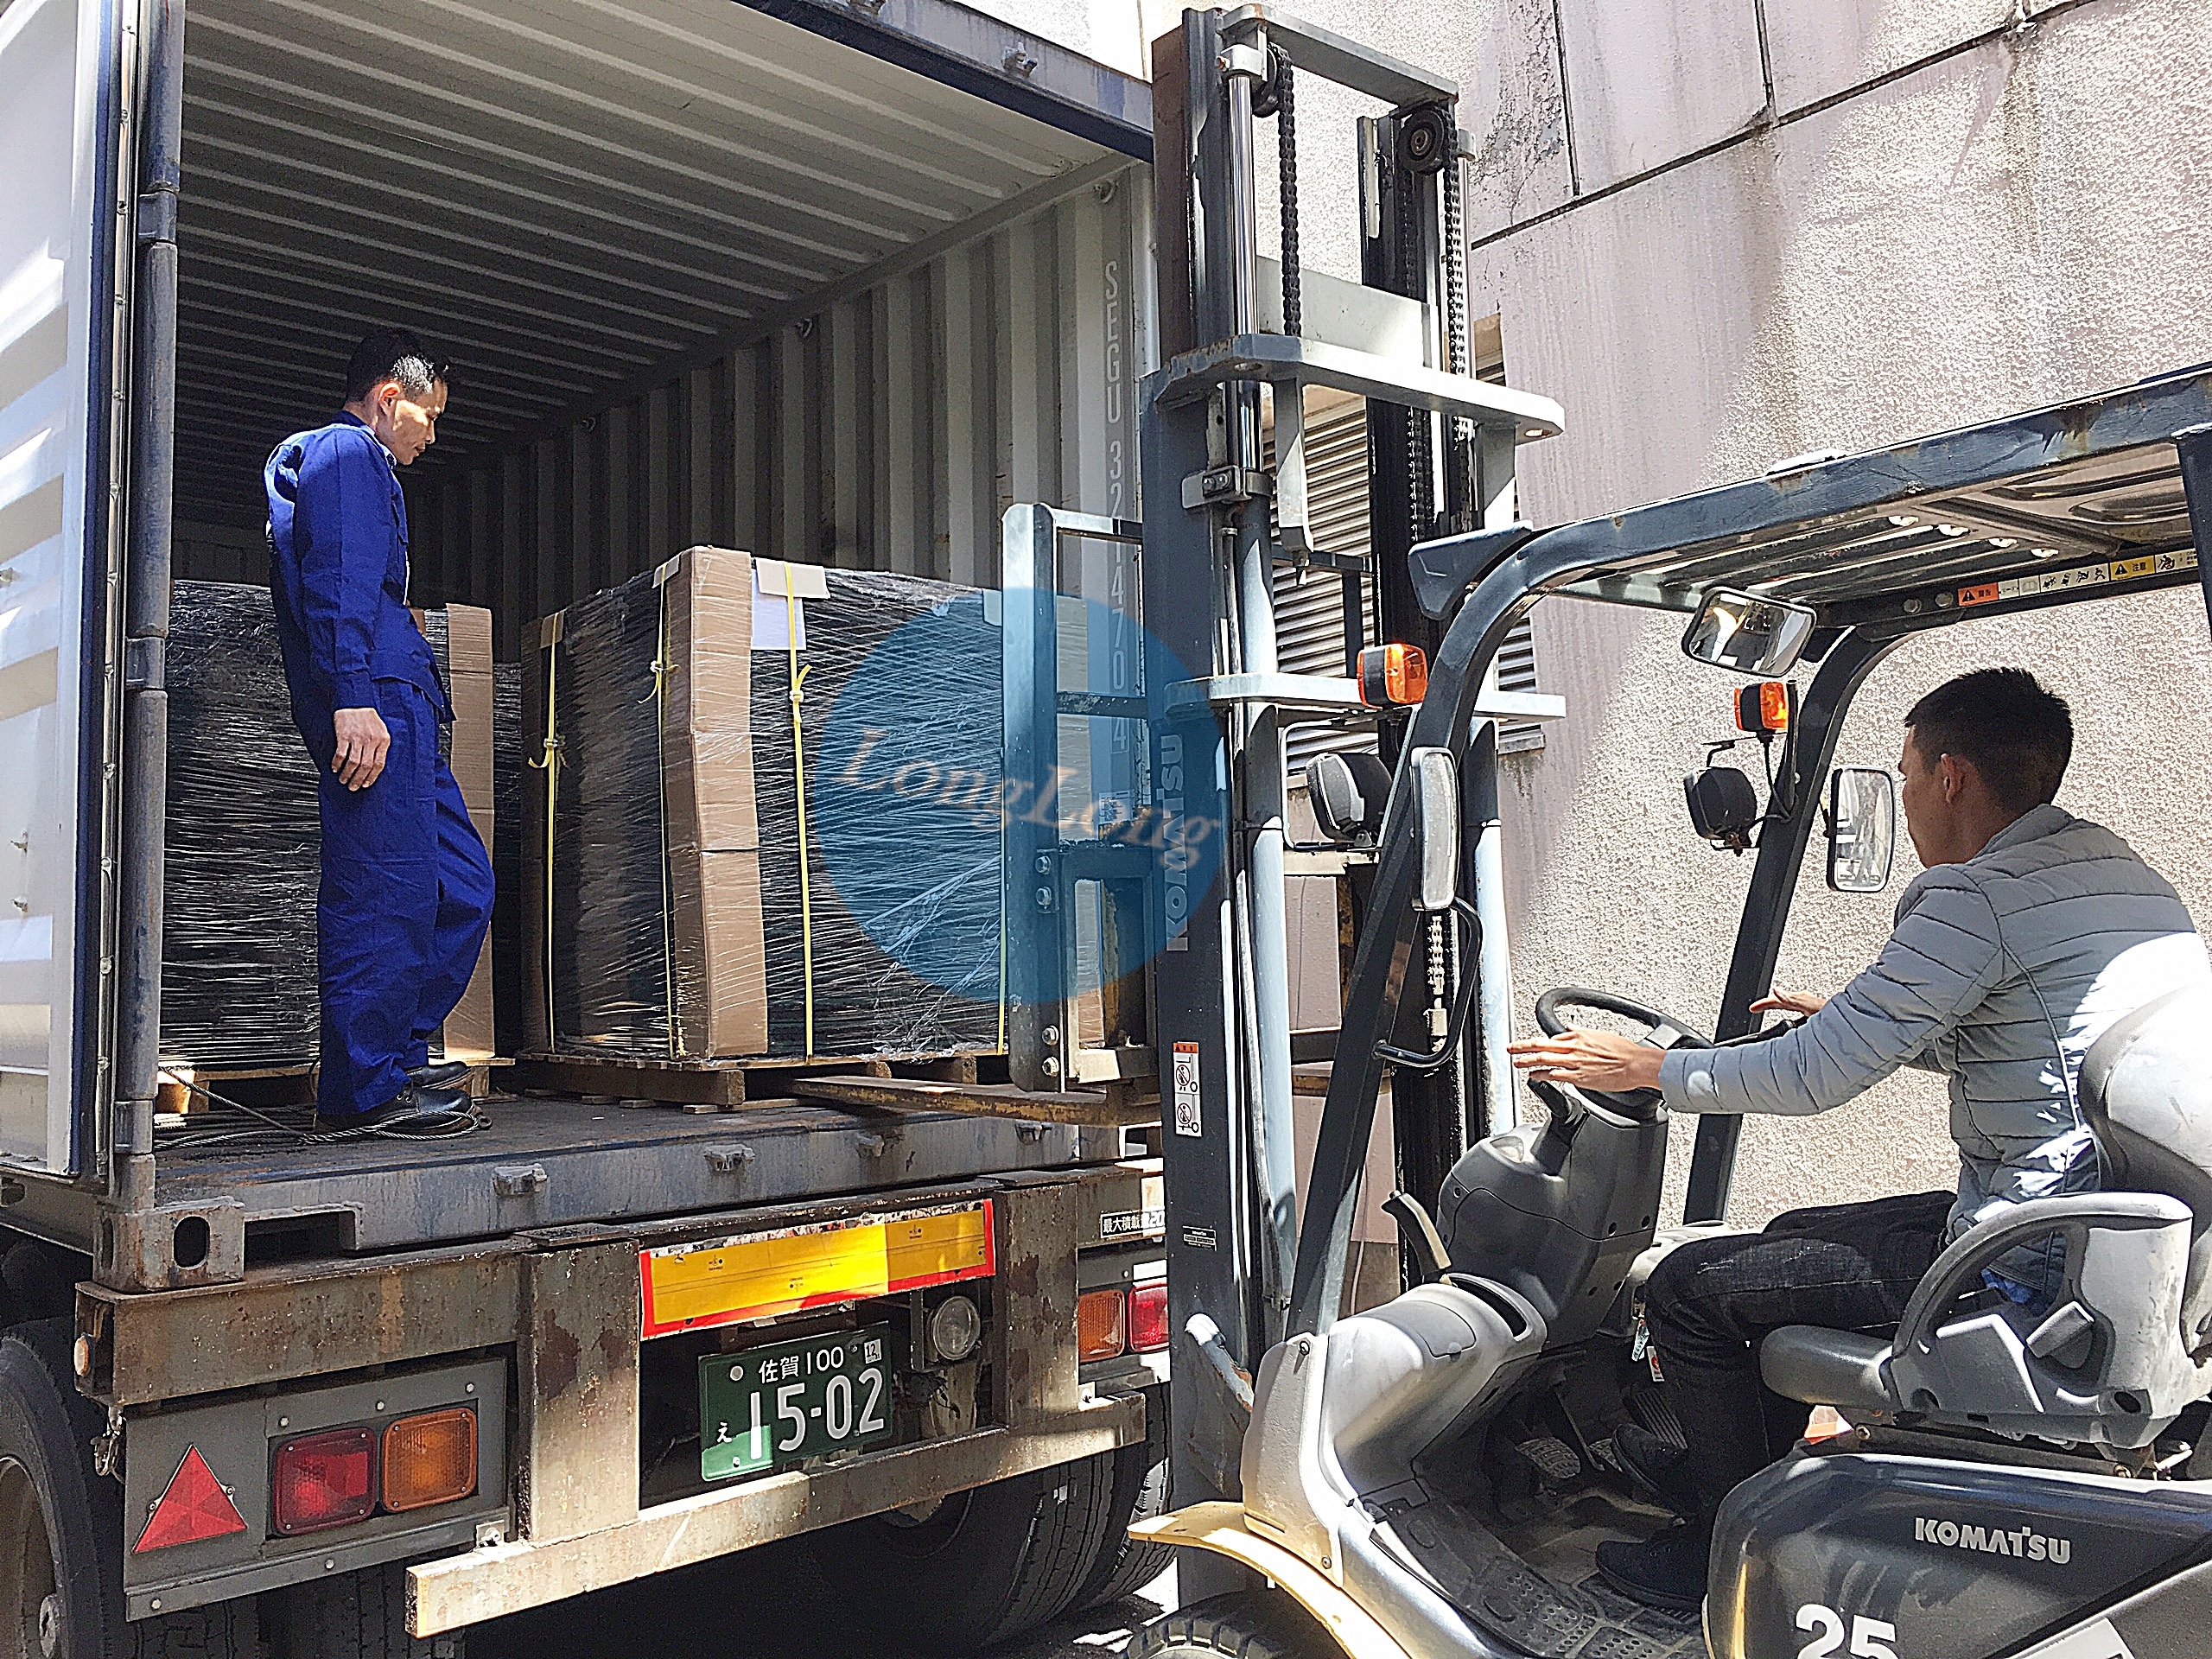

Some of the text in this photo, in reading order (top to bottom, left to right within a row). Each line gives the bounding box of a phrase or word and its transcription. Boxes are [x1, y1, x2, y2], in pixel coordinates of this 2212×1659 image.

[1105, 260, 1121, 423] SEGU
[1156, 734, 1188, 951] KOMATSU
[750, 1367, 884, 1460] 15-02
[1914, 1516, 2071, 1565] KOMATSU
[1796, 1603, 1899, 1659] 25
